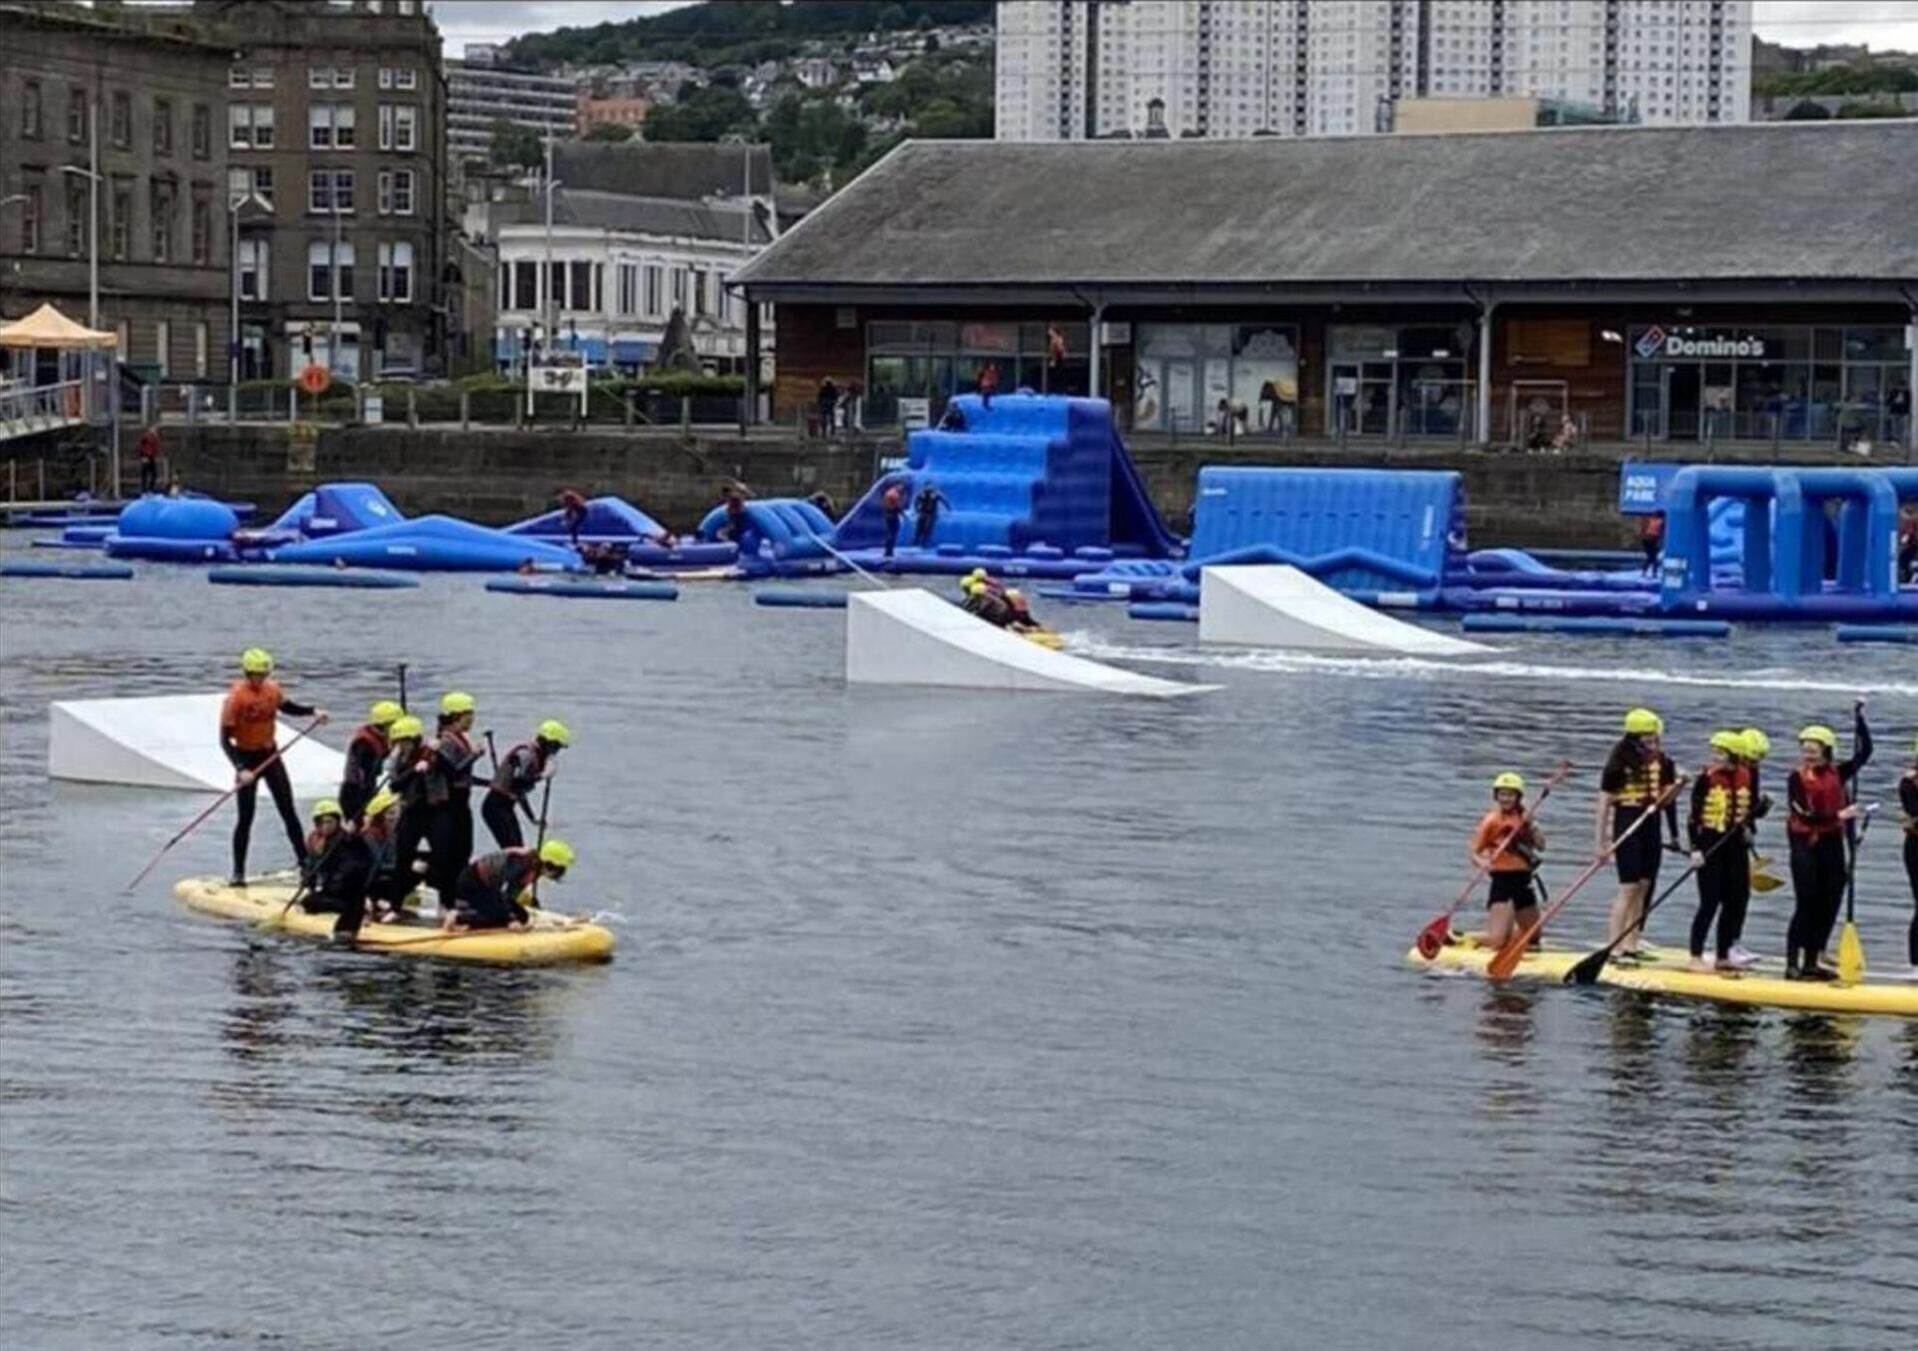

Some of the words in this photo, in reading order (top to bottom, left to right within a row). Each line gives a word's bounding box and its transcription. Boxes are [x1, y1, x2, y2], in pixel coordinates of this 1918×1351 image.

[1666, 335, 1764, 356] Domino's
[1627, 475, 1656, 488] AQUA
[1624, 490, 1655, 501] PARK
